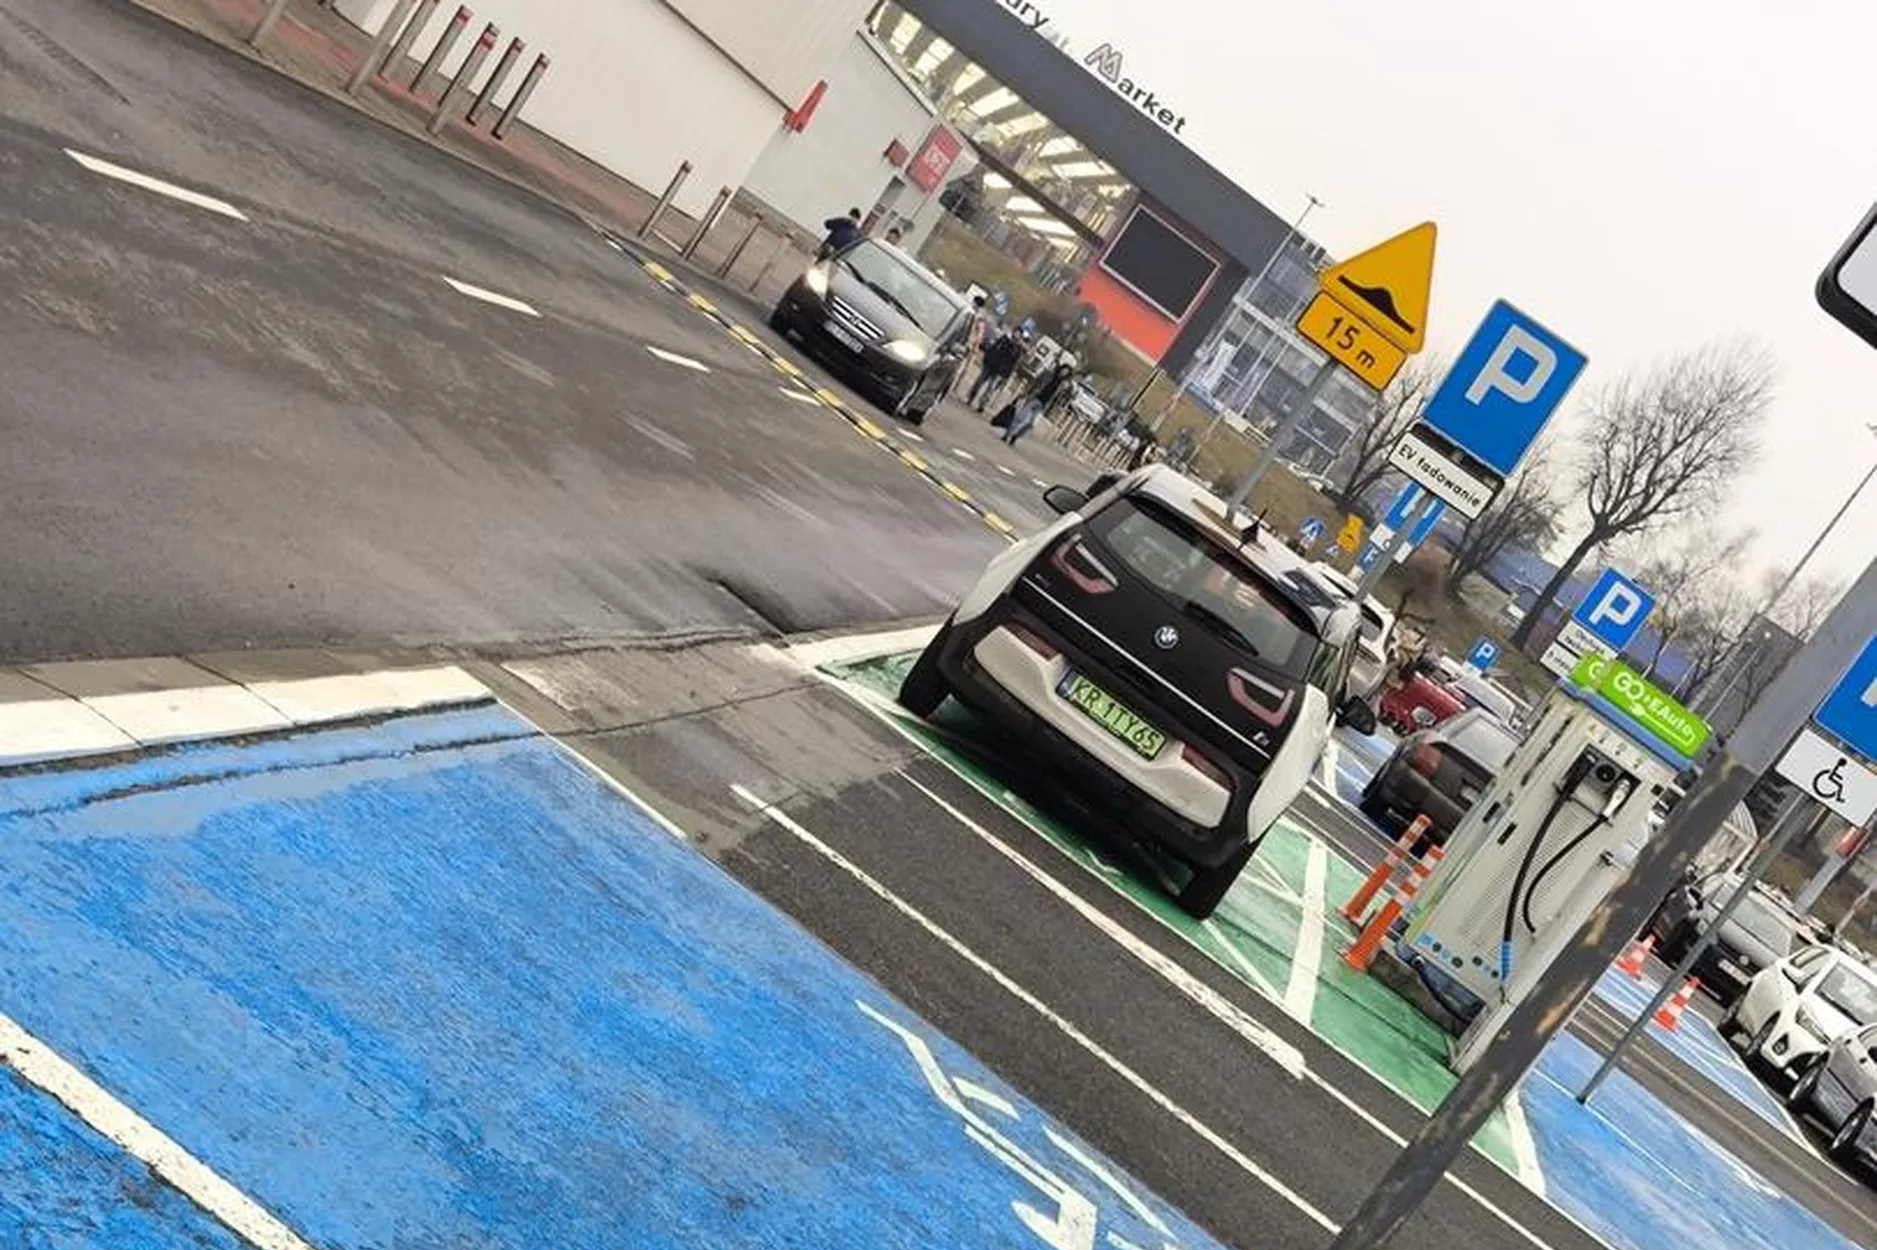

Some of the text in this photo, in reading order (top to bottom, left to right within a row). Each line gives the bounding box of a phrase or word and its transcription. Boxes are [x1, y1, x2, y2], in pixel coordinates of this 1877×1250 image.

[1084, 43, 1186, 134] Market
[1326, 317, 1376, 369] 15 m
[1464, 323, 1558, 405] P
[1398, 442, 1418, 460] EV
[1588, 581, 1642, 626] P
[1475, 642, 1496, 659] P
[1070, 678, 1160, 751] KR 1TY65
